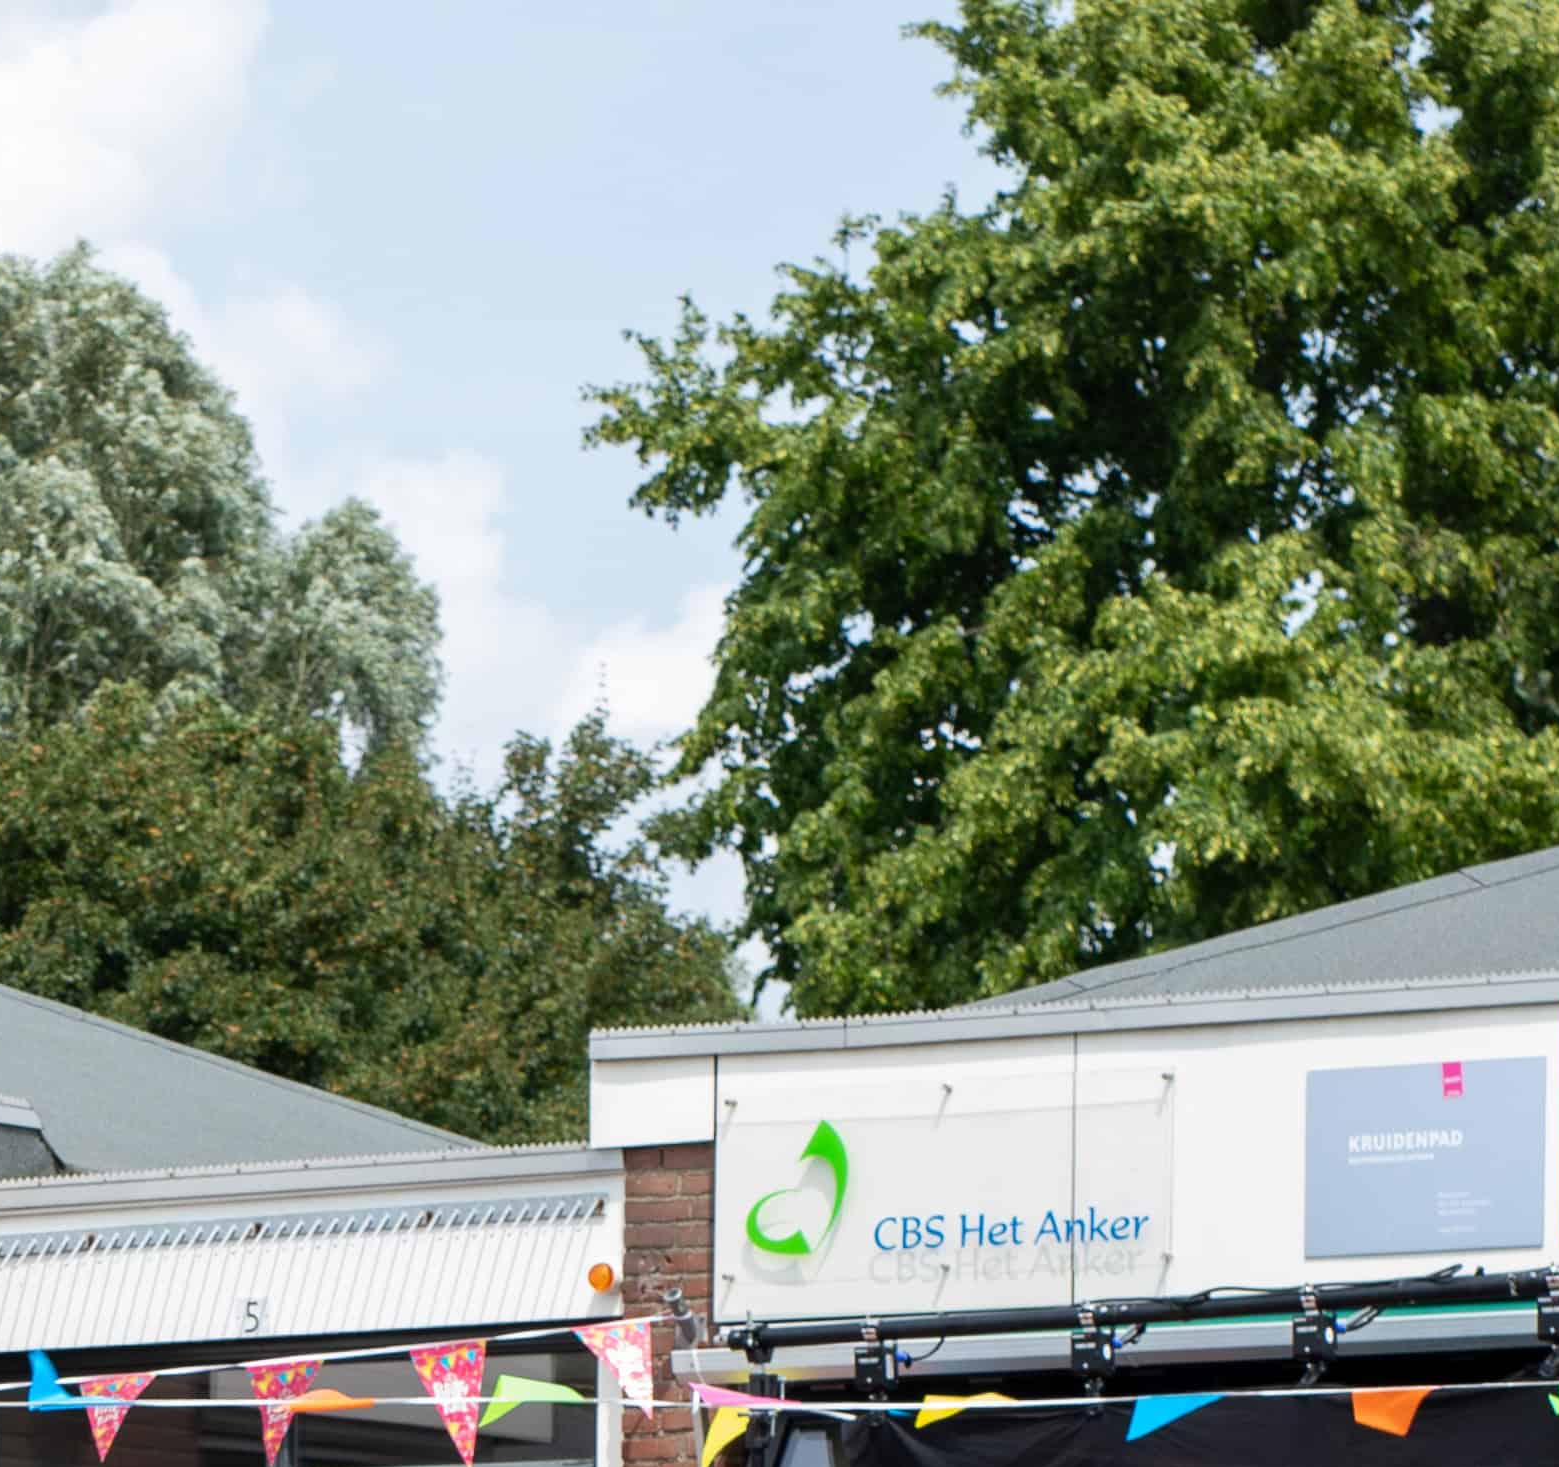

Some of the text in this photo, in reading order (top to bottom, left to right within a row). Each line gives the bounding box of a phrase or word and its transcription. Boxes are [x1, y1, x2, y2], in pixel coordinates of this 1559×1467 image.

[1348, 1130, 1463, 1152] KRUIDENPAD
[873, 1206, 1149, 1251] CBS Het Anker
[244, 1301, 259, 1333] 5
